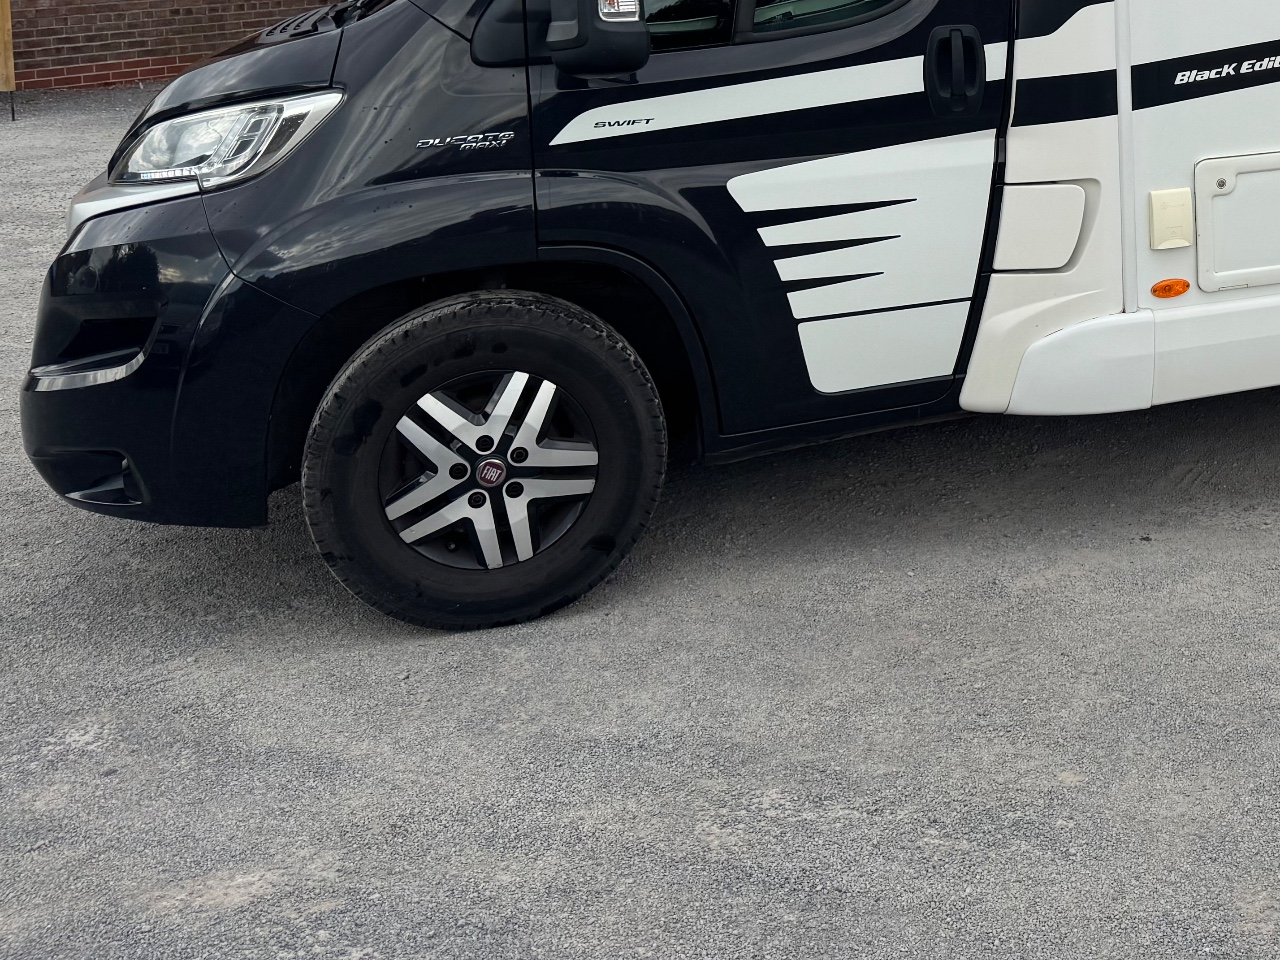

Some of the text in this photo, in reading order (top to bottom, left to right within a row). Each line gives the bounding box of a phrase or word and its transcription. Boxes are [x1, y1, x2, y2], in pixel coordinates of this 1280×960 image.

[593, 117, 655, 128] SWIFT
[415, 131, 515, 149] DUCATO
[481, 465, 502, 482] FIAT
